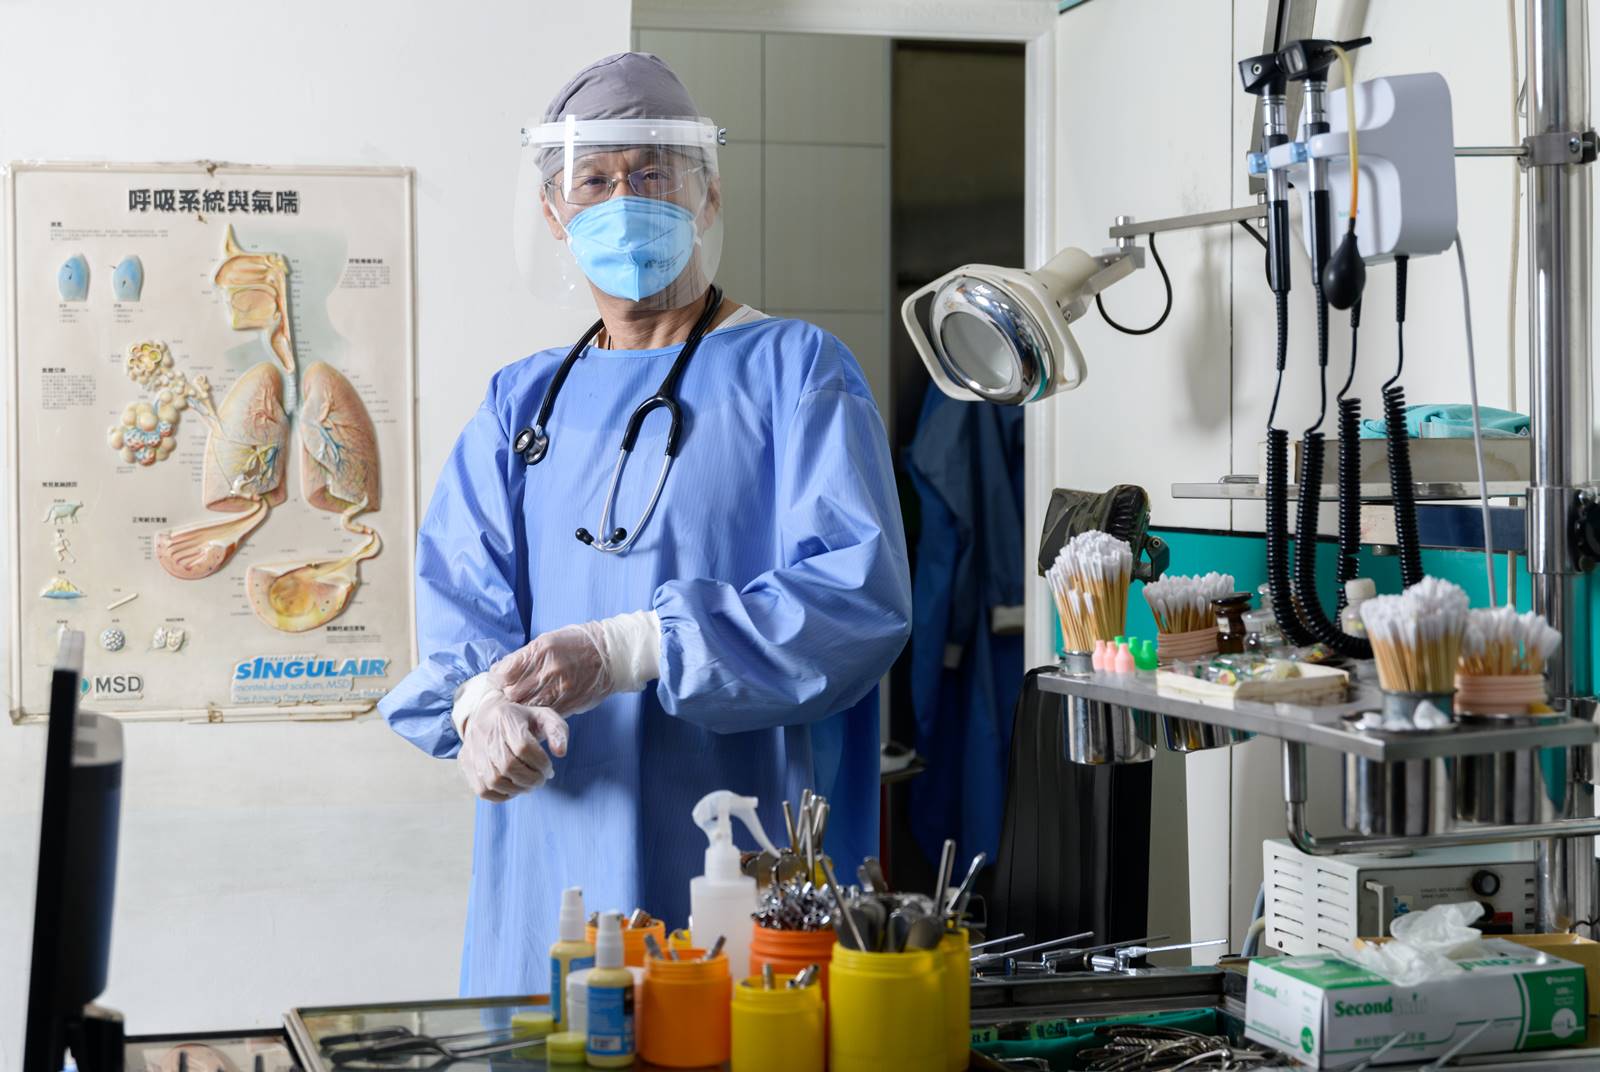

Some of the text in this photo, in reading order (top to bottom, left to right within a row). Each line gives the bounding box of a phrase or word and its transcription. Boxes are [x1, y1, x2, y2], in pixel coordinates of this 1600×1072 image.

[128, 188, 299, 213] 呼吸系統與氣喘
[95, 675, 141, 693] MSD
[1334, 996, 1393, 1018] Second
